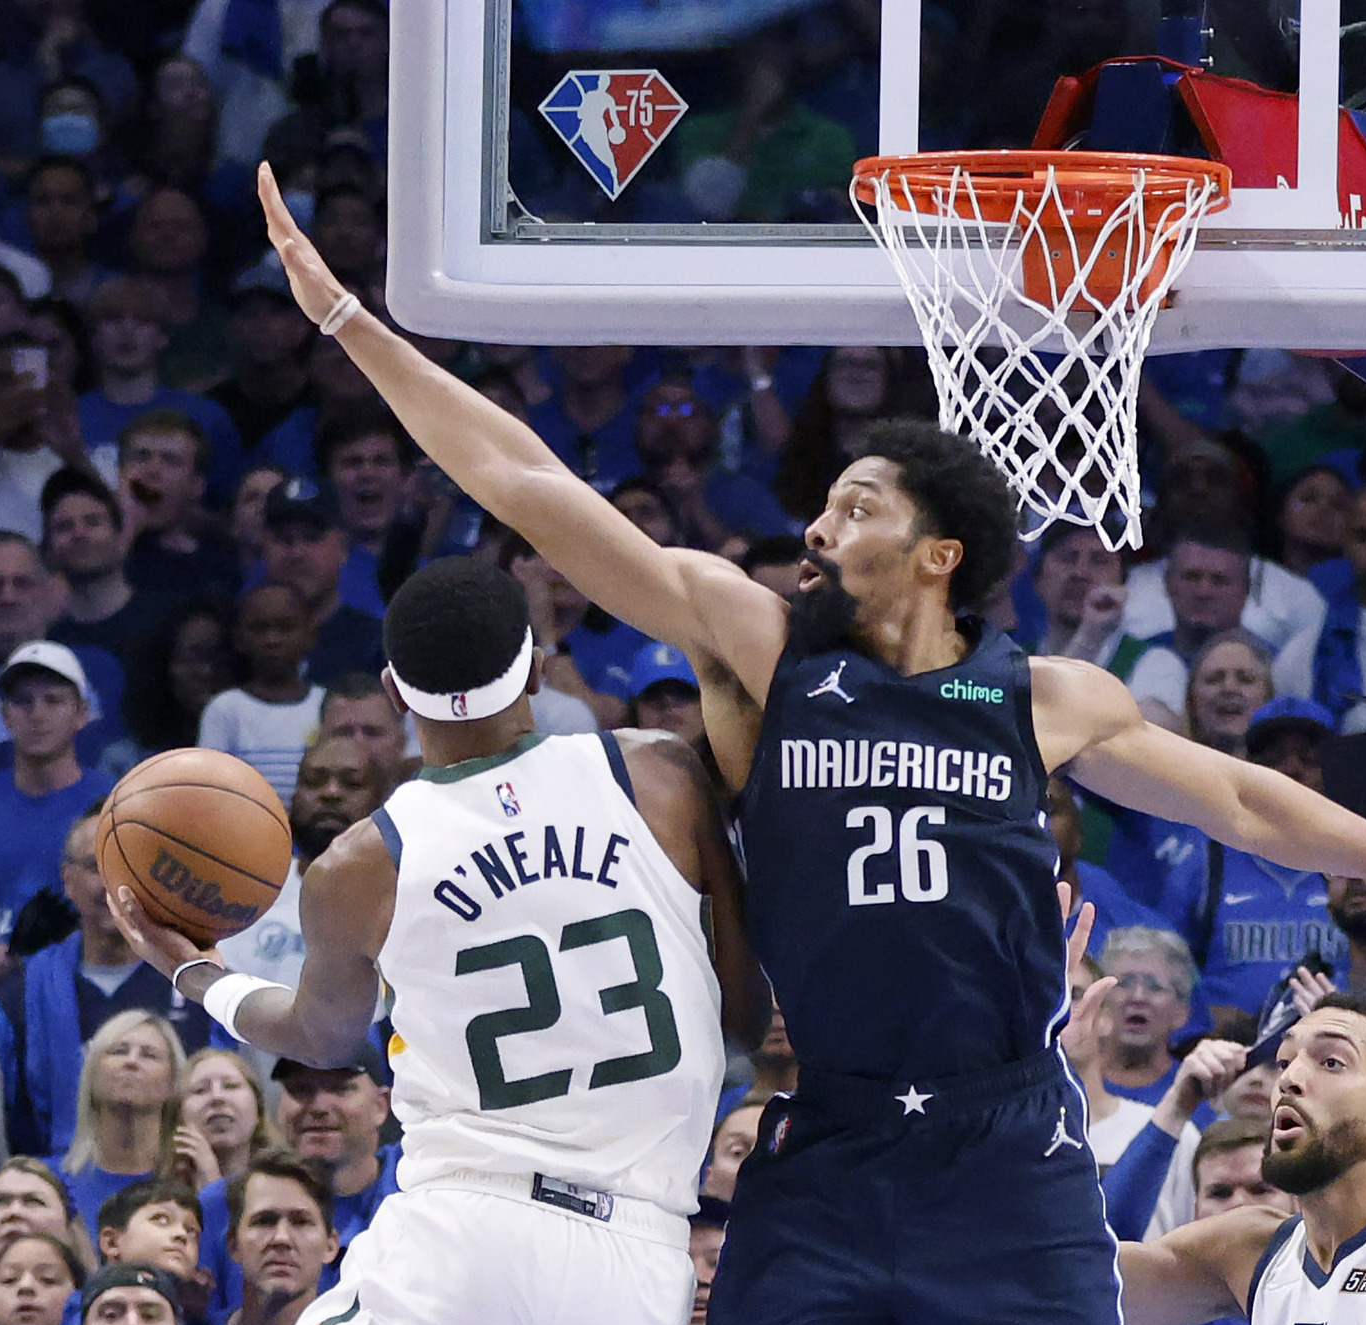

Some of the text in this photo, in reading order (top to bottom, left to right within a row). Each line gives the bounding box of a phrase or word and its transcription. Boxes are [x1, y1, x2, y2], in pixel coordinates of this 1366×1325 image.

[626, 90, 653, 127] 75
[940, 679, 1004, 704] chime
[781, 739, 1012, 801] MAVERICKS
[150, 847, 260, 923] Wilson
[433, 825, 630, 922] O'NEALE
[846, 806, 949, 906] 26
[455, 908, 682, 1111] 23
